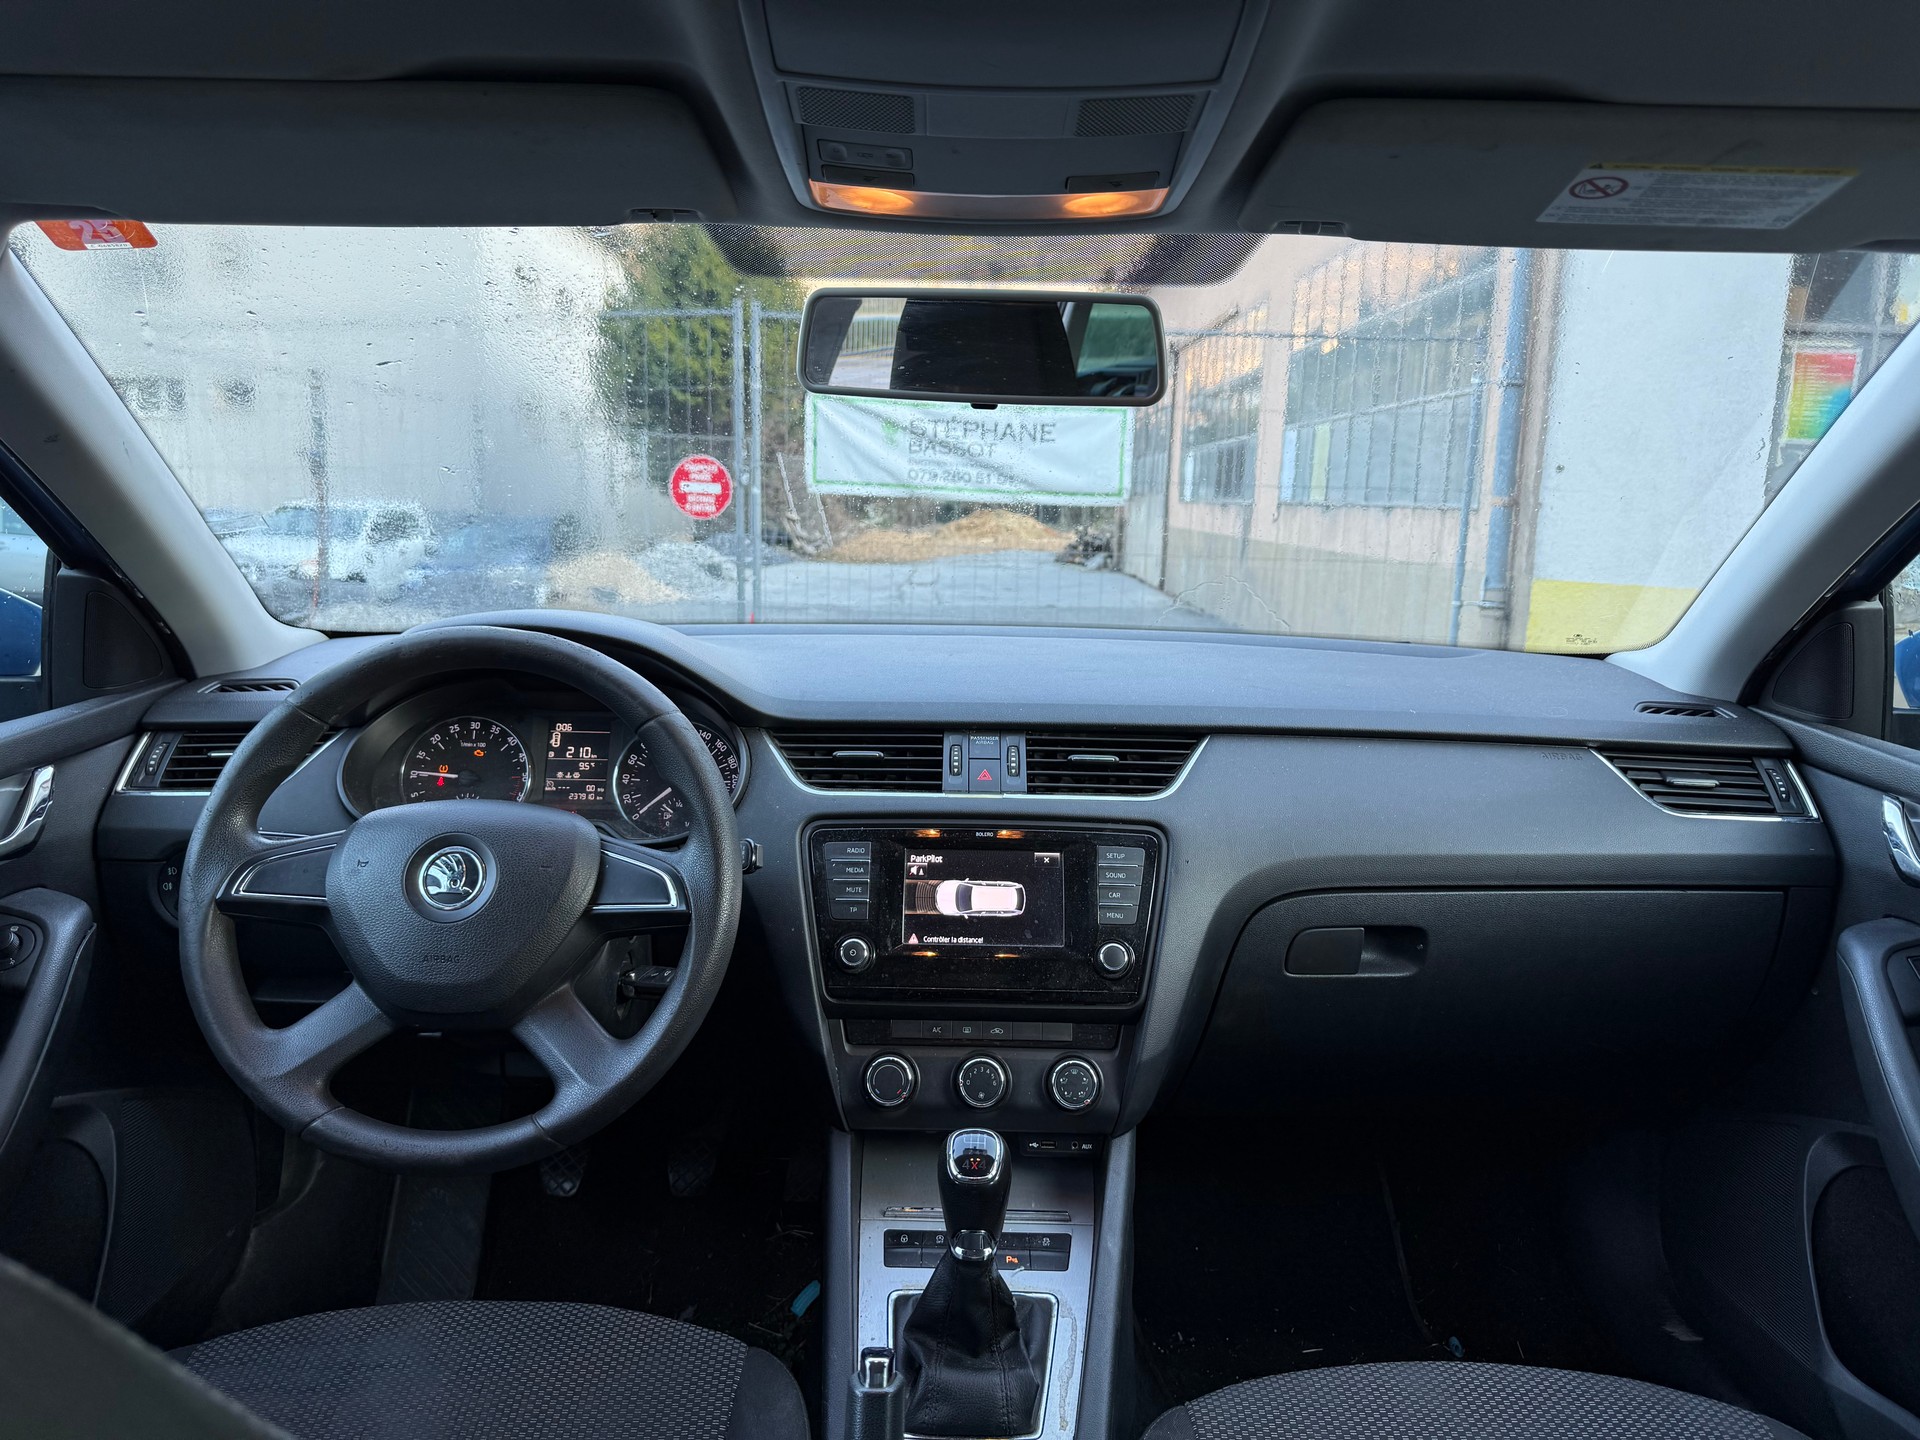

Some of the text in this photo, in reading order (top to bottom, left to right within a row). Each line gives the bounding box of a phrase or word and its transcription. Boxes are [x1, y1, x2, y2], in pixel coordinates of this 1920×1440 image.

[449, 724, 460, 733] 25
[470, 722, 481, 730] 30
[490, 725, 501, 734] 35
[430, 734, 441, 744] 20
[507, 736, 518, 746] 40
[714, 739, 727, 752] 160
[416, 751, 426, 759] 15
[566, 746, 591, 758] 210
[627, 754, 638, 765] 60
[727, 755, 737, 769] 180
[410, 770, 418, 779] 10
[622, 774, 631, 785] 40
[623, 793, 632, 804] 20
[910, 854, 943, 863] ParkPilot
[923, 935, 950, 943] Contrôler
[421, 954, 461, 964] AIRBAG
